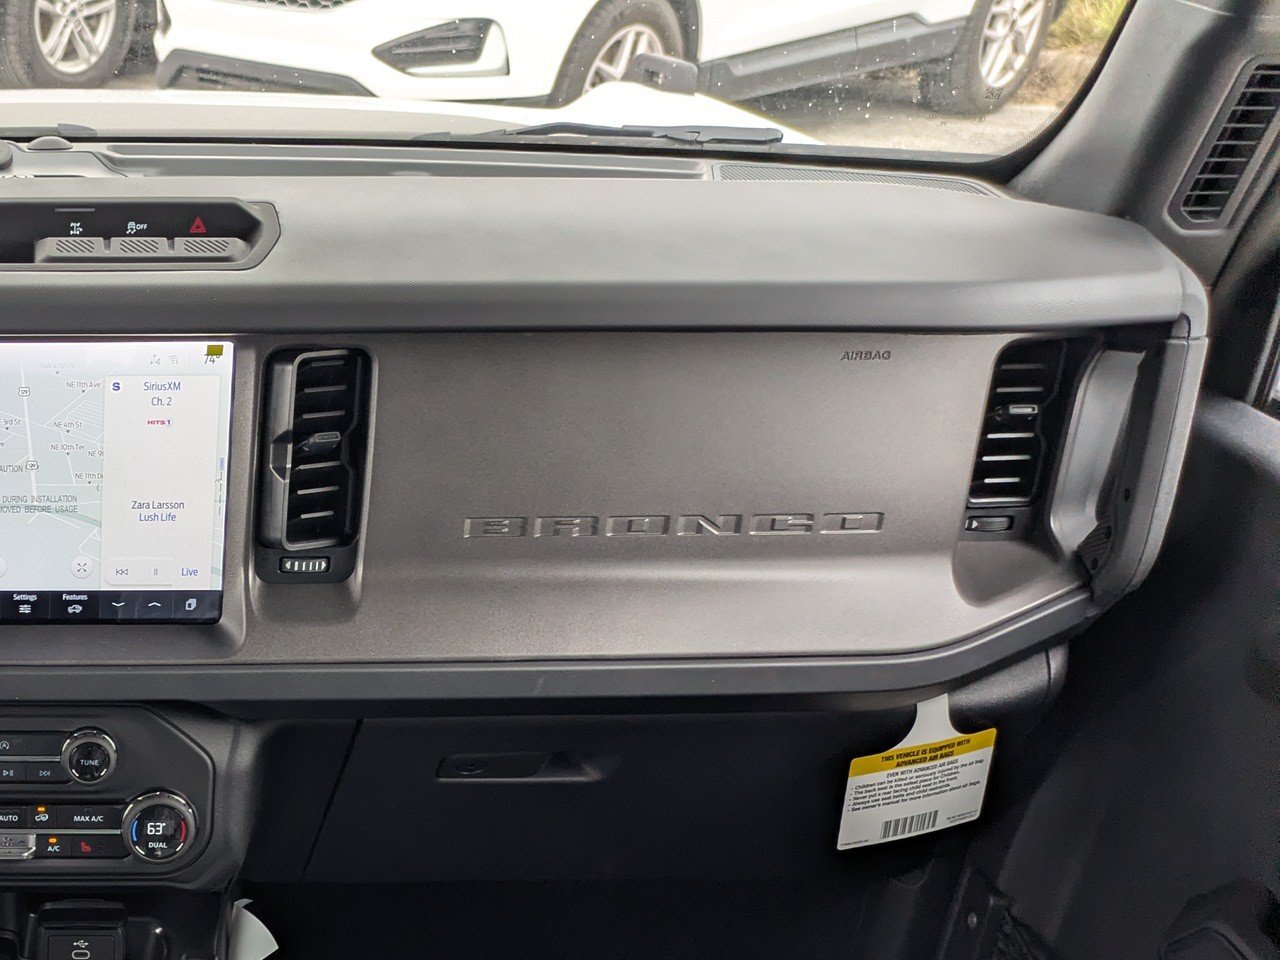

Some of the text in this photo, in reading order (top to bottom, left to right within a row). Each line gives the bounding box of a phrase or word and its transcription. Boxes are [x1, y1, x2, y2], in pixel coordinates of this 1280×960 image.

[841, 350, 891, 360] AIRBAG
[144, 382, 181, 391] SiriusXM
[151, 397, 172, 406] Ch. 2
[131, 501, 184, 509] Zara Larsson
[139, 513, 176, 521] Lush Life
[463, 511, 884, 538] BRONCO
[181, 568, 198, 577] Live
[896, 750, 920, 759] VEHICLE
[929, 742, 955, 753] EQUIPPED
[956, 738, 971, 747] WITH
[895, 756, 927, 767] ADVANCED
[939, 750, 954, 759] BAGS
